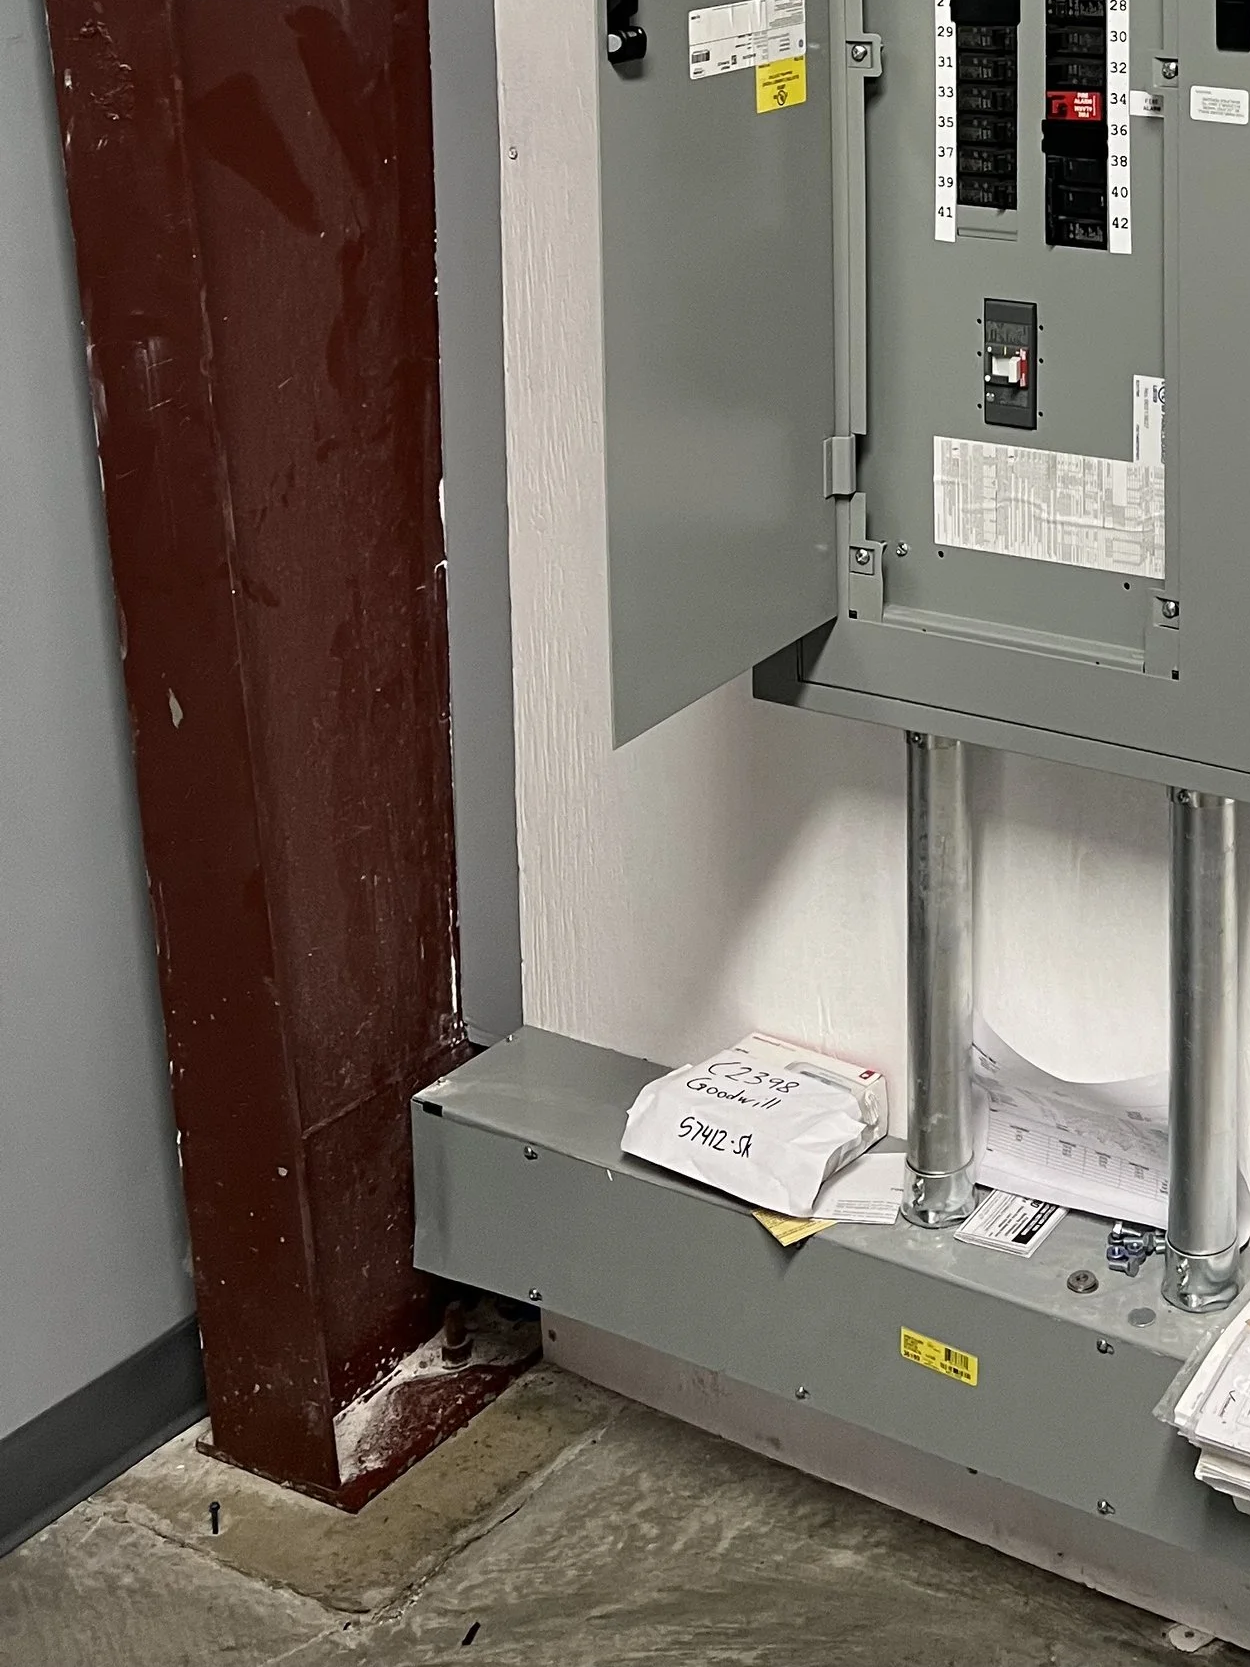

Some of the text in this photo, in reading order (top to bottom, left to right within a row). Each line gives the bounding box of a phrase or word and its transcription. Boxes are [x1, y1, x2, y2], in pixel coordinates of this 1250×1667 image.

[1110, 0, 1127, 11] 28
[938, 26, 953, 38] 29
[1110, 31, 1127, 43] 30
[938, 56, 953, 68] 31
[1110, 62, 1127, 74] 32
[938, 86, 953, 98] 33
[1110, 93, 1127, 105] 34
[938, 116, 953, 128] 35
[1111, 124, 1127, 136] 36
[938, 146, 953, 158] 37
[1111, 155, 1128, 167] 38
[938, 176, 953, 188] 39
[1111, 186, 1128, 198] 40
[938, 206, 953, 218] 41
[1112, 217, 1128, 229] 42
[707, 1061, 800, 1093] C2398
[686, 1077, 782, 1110] Goodwill
